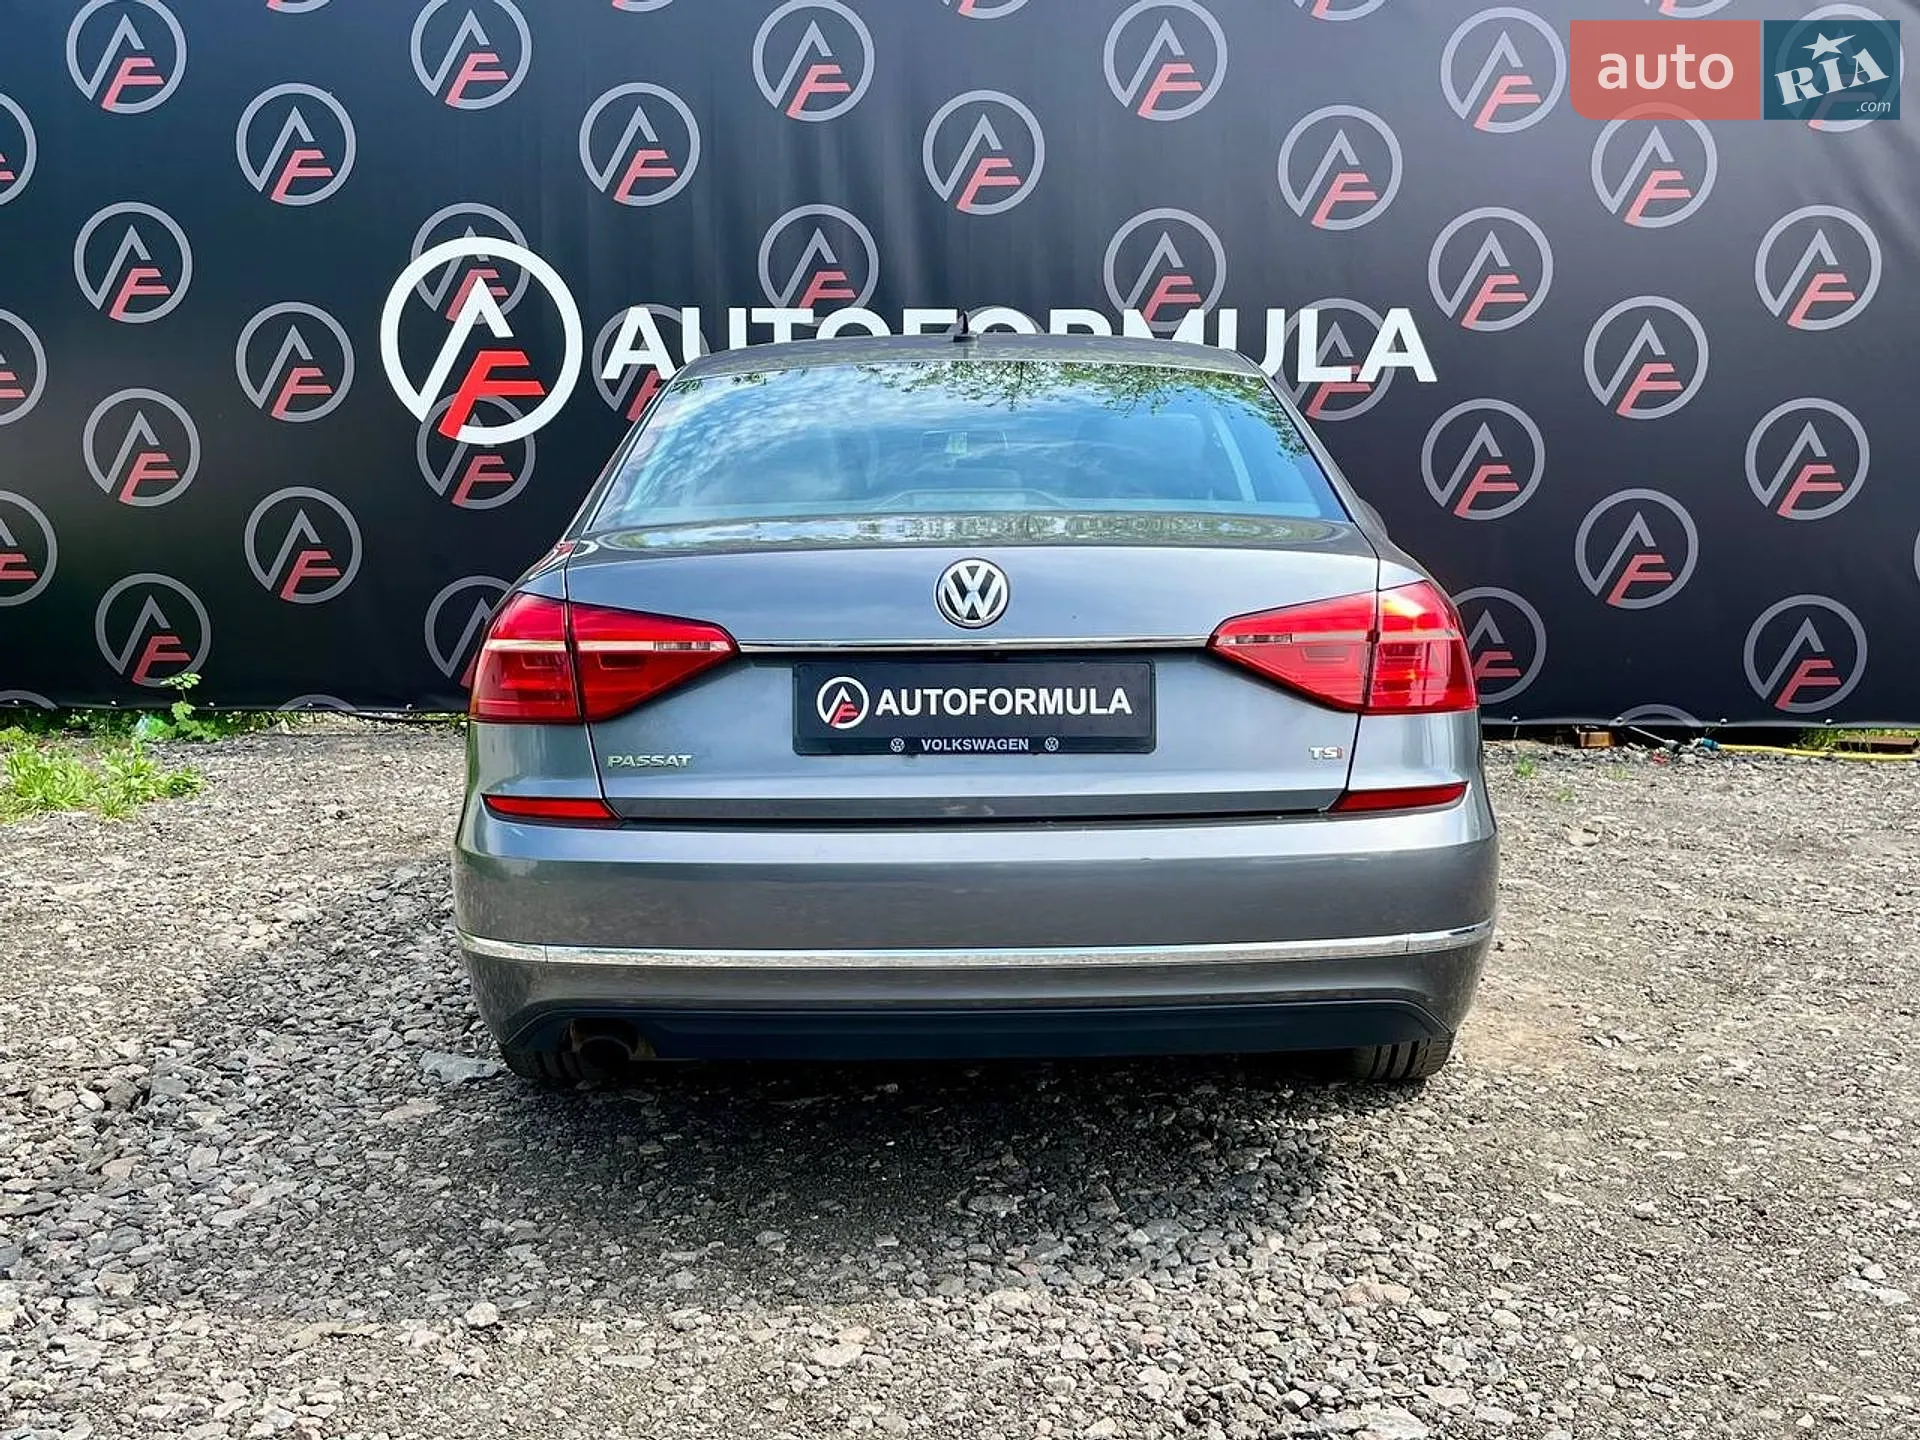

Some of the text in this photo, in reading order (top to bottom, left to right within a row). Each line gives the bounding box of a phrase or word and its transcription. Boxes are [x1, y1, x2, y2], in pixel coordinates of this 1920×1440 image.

[876, 688, 1133, 716] AUTOFORMULA
[921, 738, 1029, 751] VOLKSWAGEN
[1309, 746, 1343, 760] TSI
[607, 754, 692, 768] PASSAT
